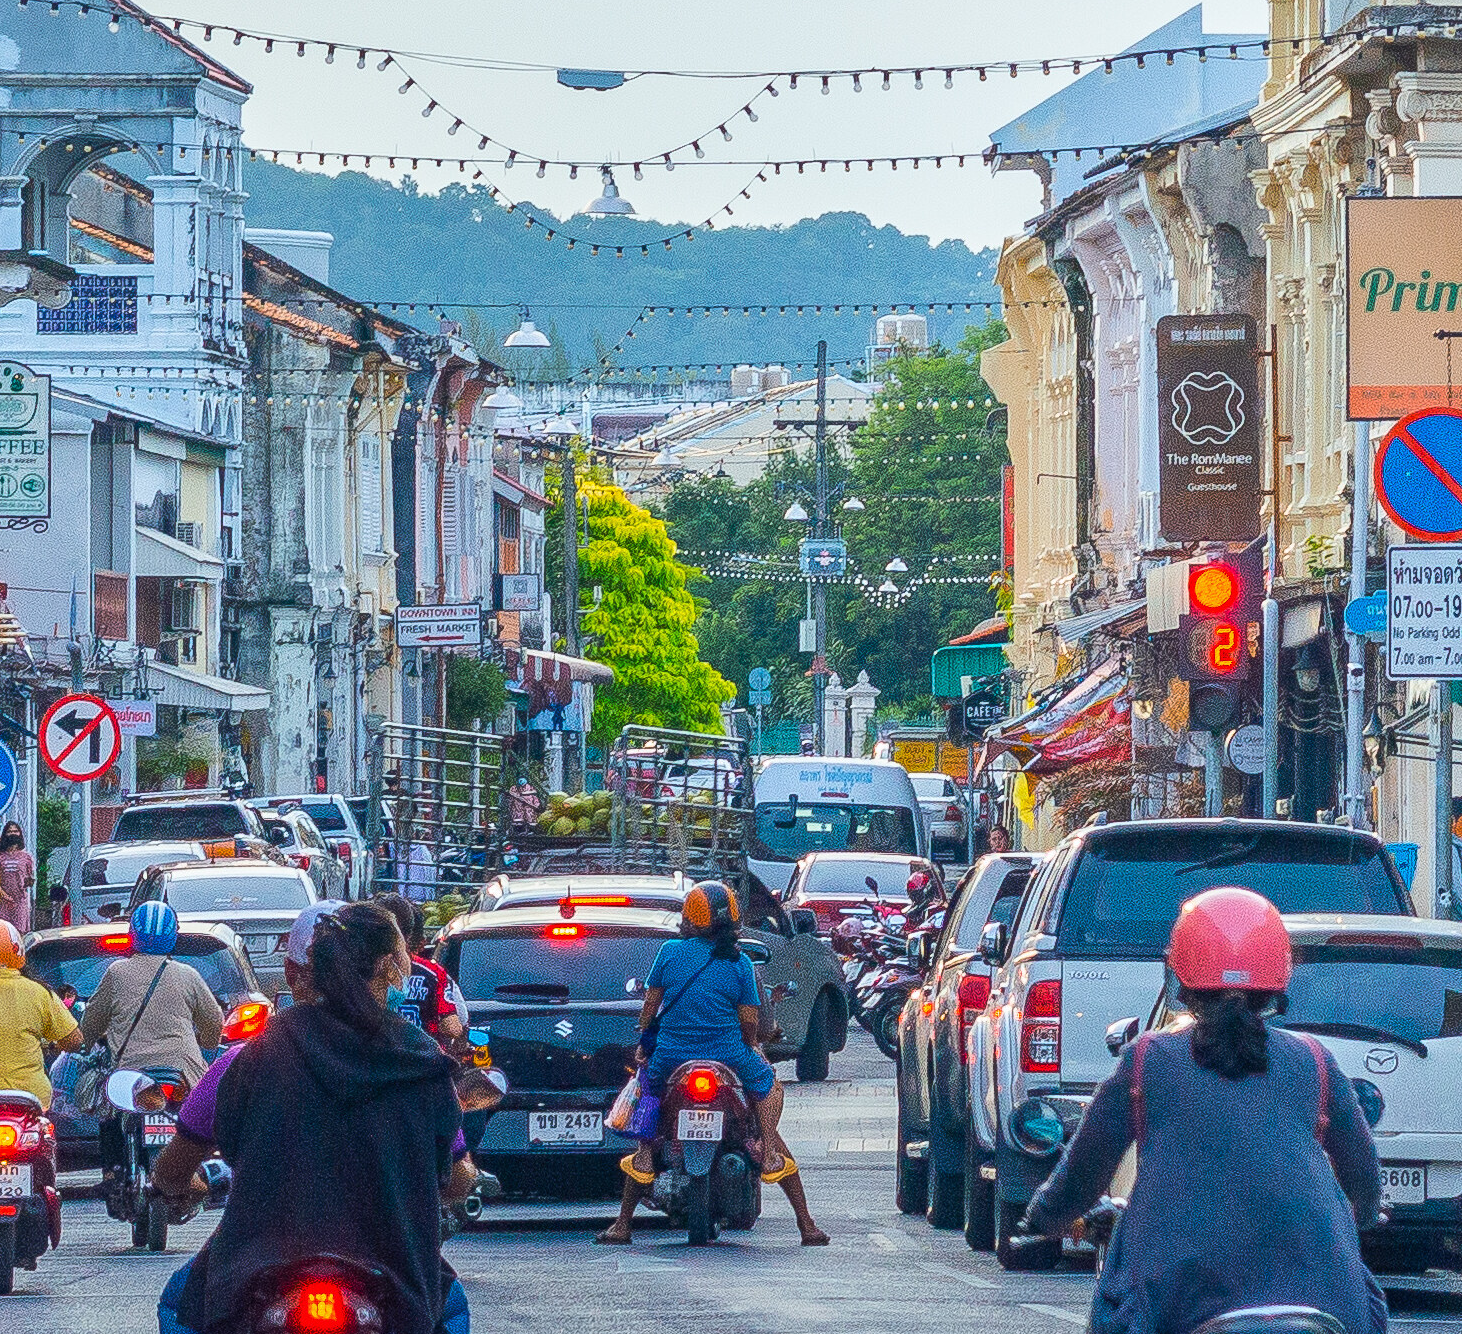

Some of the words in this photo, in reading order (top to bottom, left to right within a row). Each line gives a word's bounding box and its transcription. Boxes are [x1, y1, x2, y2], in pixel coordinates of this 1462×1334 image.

[1166, 453, 1190, 465] The
[400, 624, 432, 635] FRESH
[436, 623, 478, 634] MARKET
[1393, 627, 1405, 639] No
[1407, 627, 1438, 641] Parking
[1442, 626, 1461, 639] Odd
[1068, 970, 1111, 981] TOYOTA
